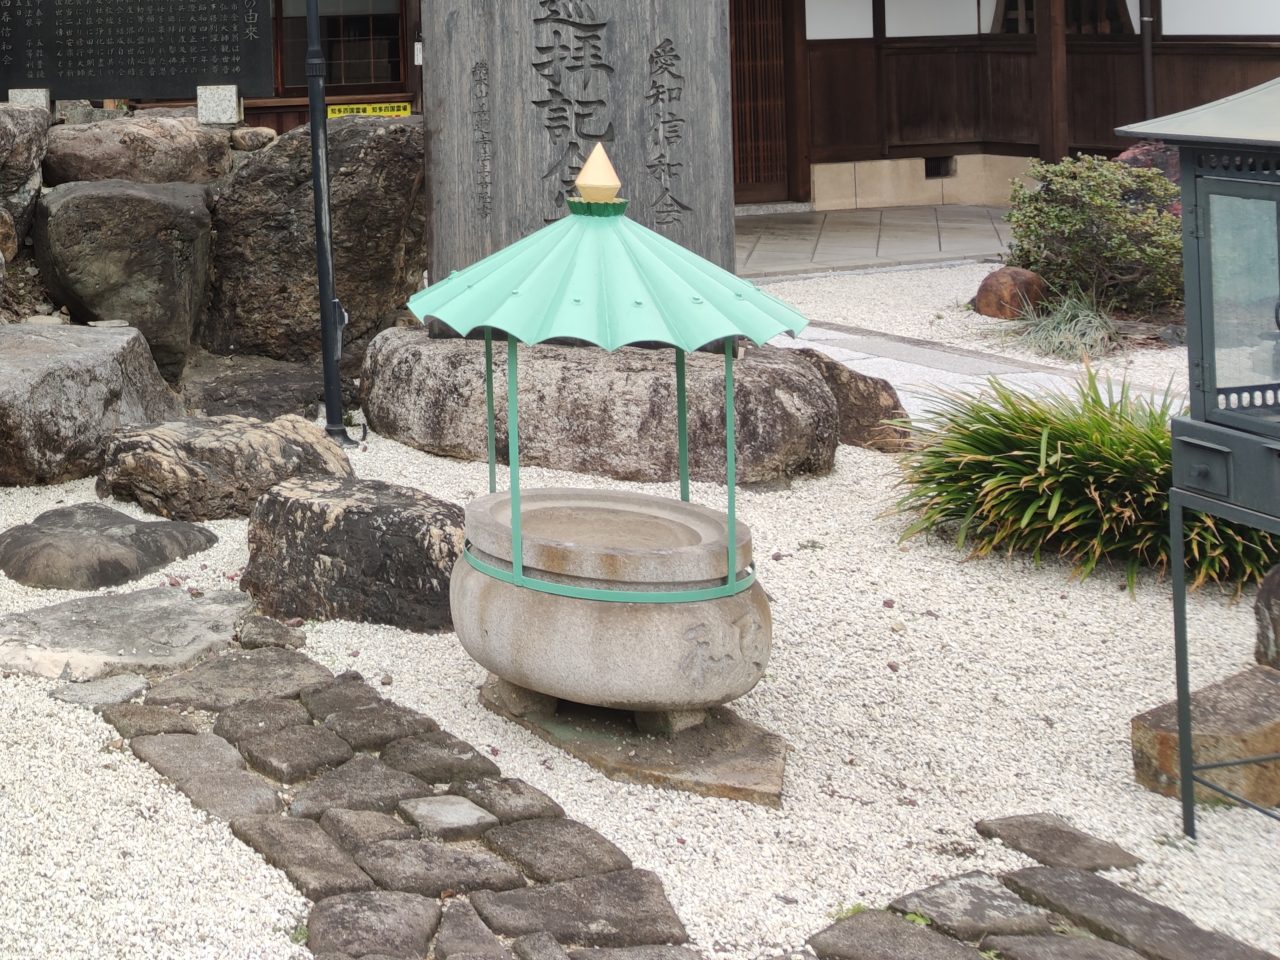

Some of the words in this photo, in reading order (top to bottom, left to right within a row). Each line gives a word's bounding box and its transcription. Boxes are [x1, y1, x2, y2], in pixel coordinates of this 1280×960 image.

[644, 38, 693, 226] 愛知信和会
